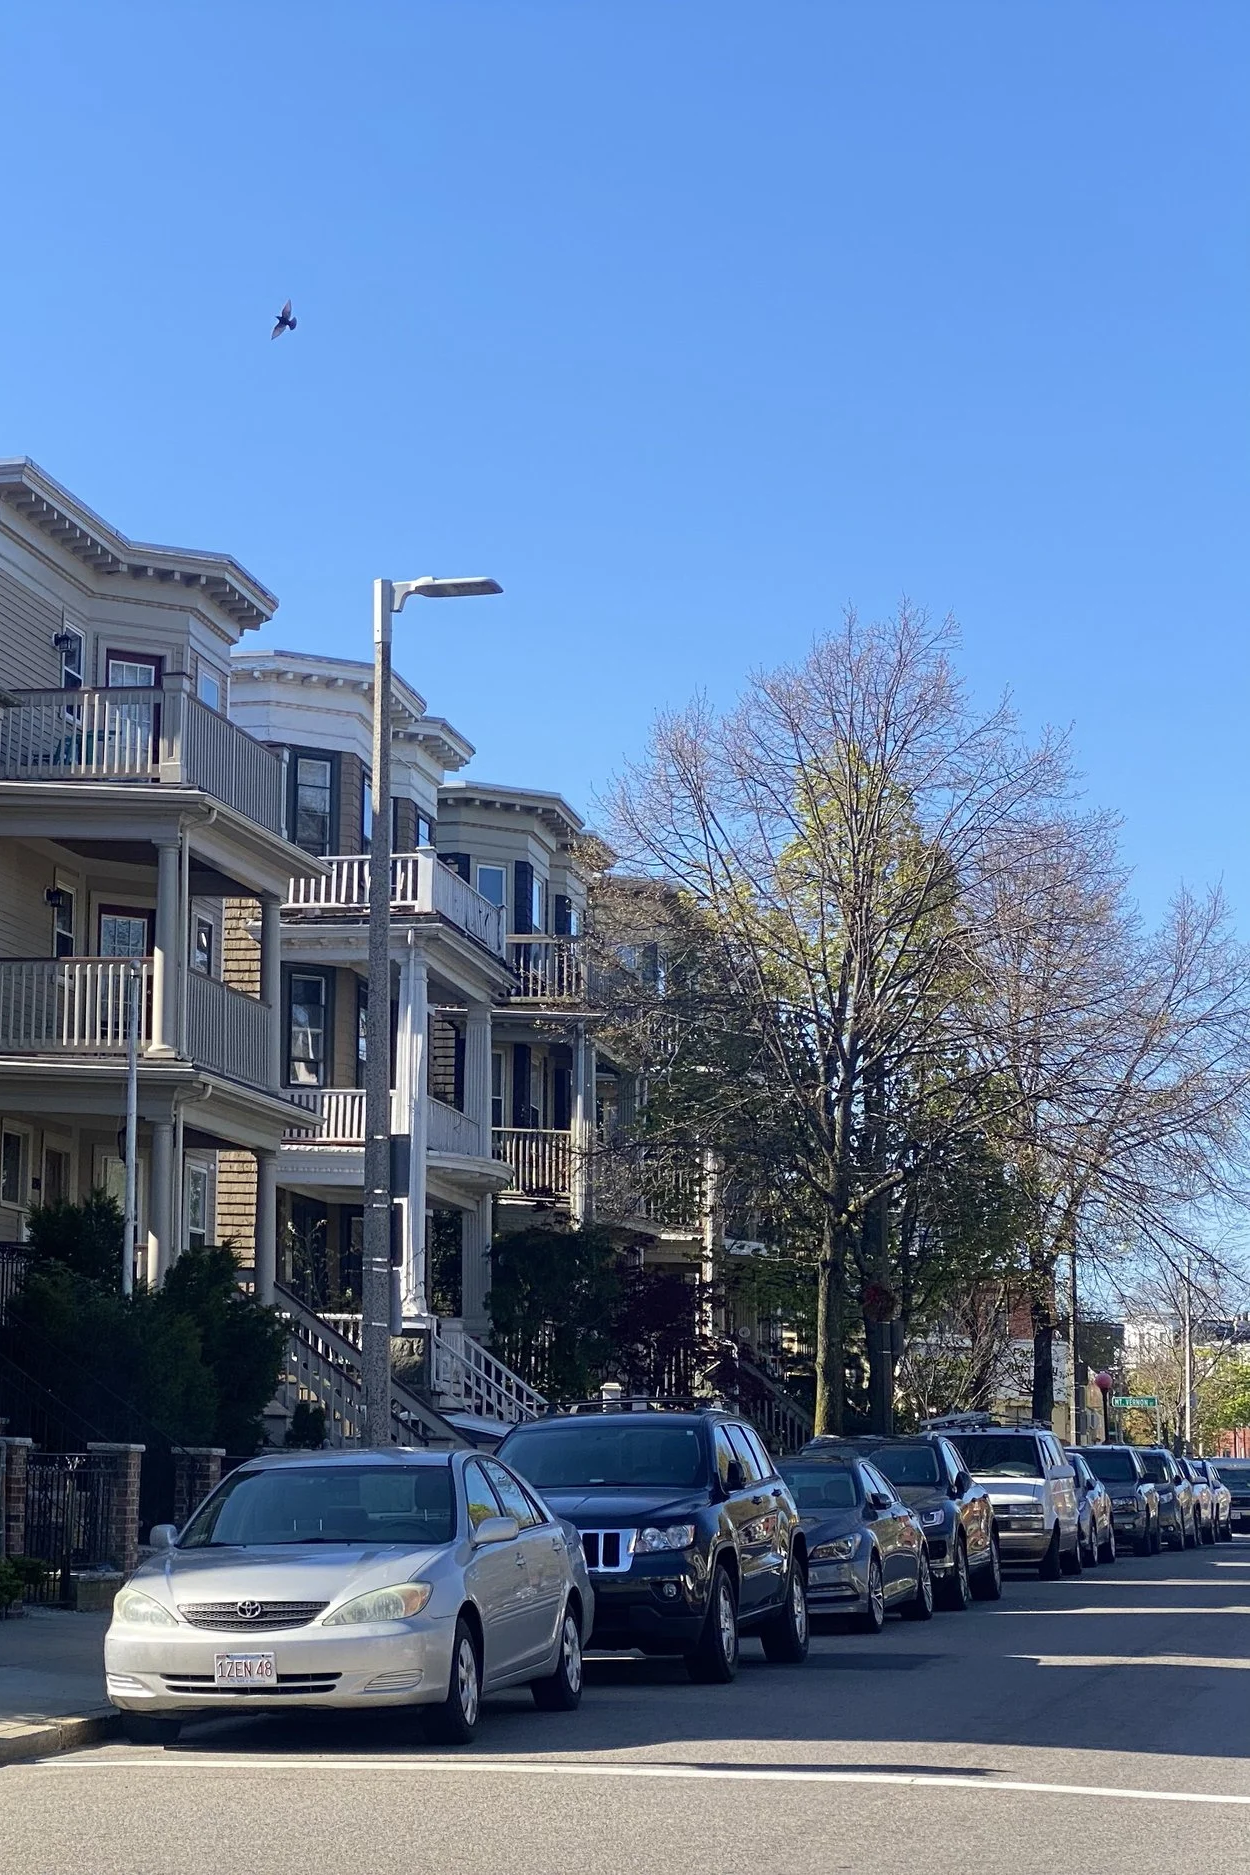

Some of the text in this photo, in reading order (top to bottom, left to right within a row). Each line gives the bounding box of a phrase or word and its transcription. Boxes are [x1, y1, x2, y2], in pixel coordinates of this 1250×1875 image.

[1125, 1398, 1148, 1406] VERNON
[218, 1660, 273, 1678] 1ZEN 48
